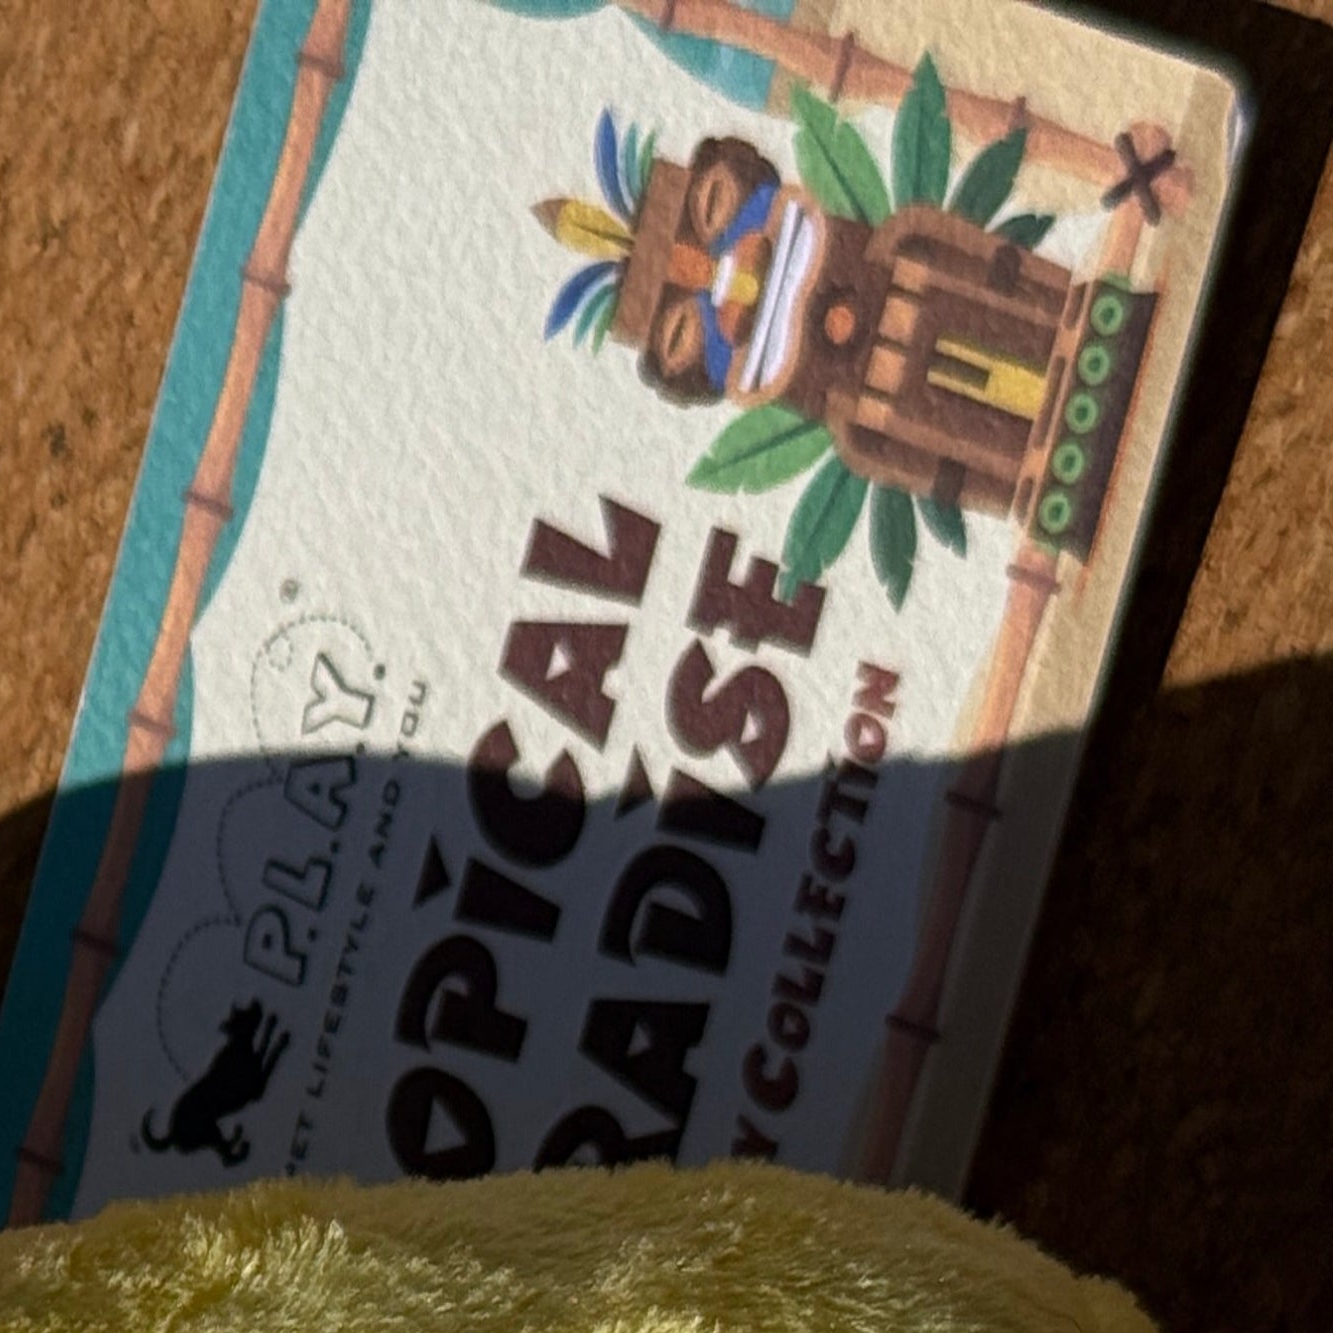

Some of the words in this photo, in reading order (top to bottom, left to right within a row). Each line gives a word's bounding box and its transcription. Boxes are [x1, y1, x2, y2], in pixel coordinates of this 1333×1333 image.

[307, 880, 375, 1098] LIFESTYLE
[369, 779, 401, 868] AND
[393, 679, 427, 762] YOU
[741, 659, 900, 1112] COLLECTION
